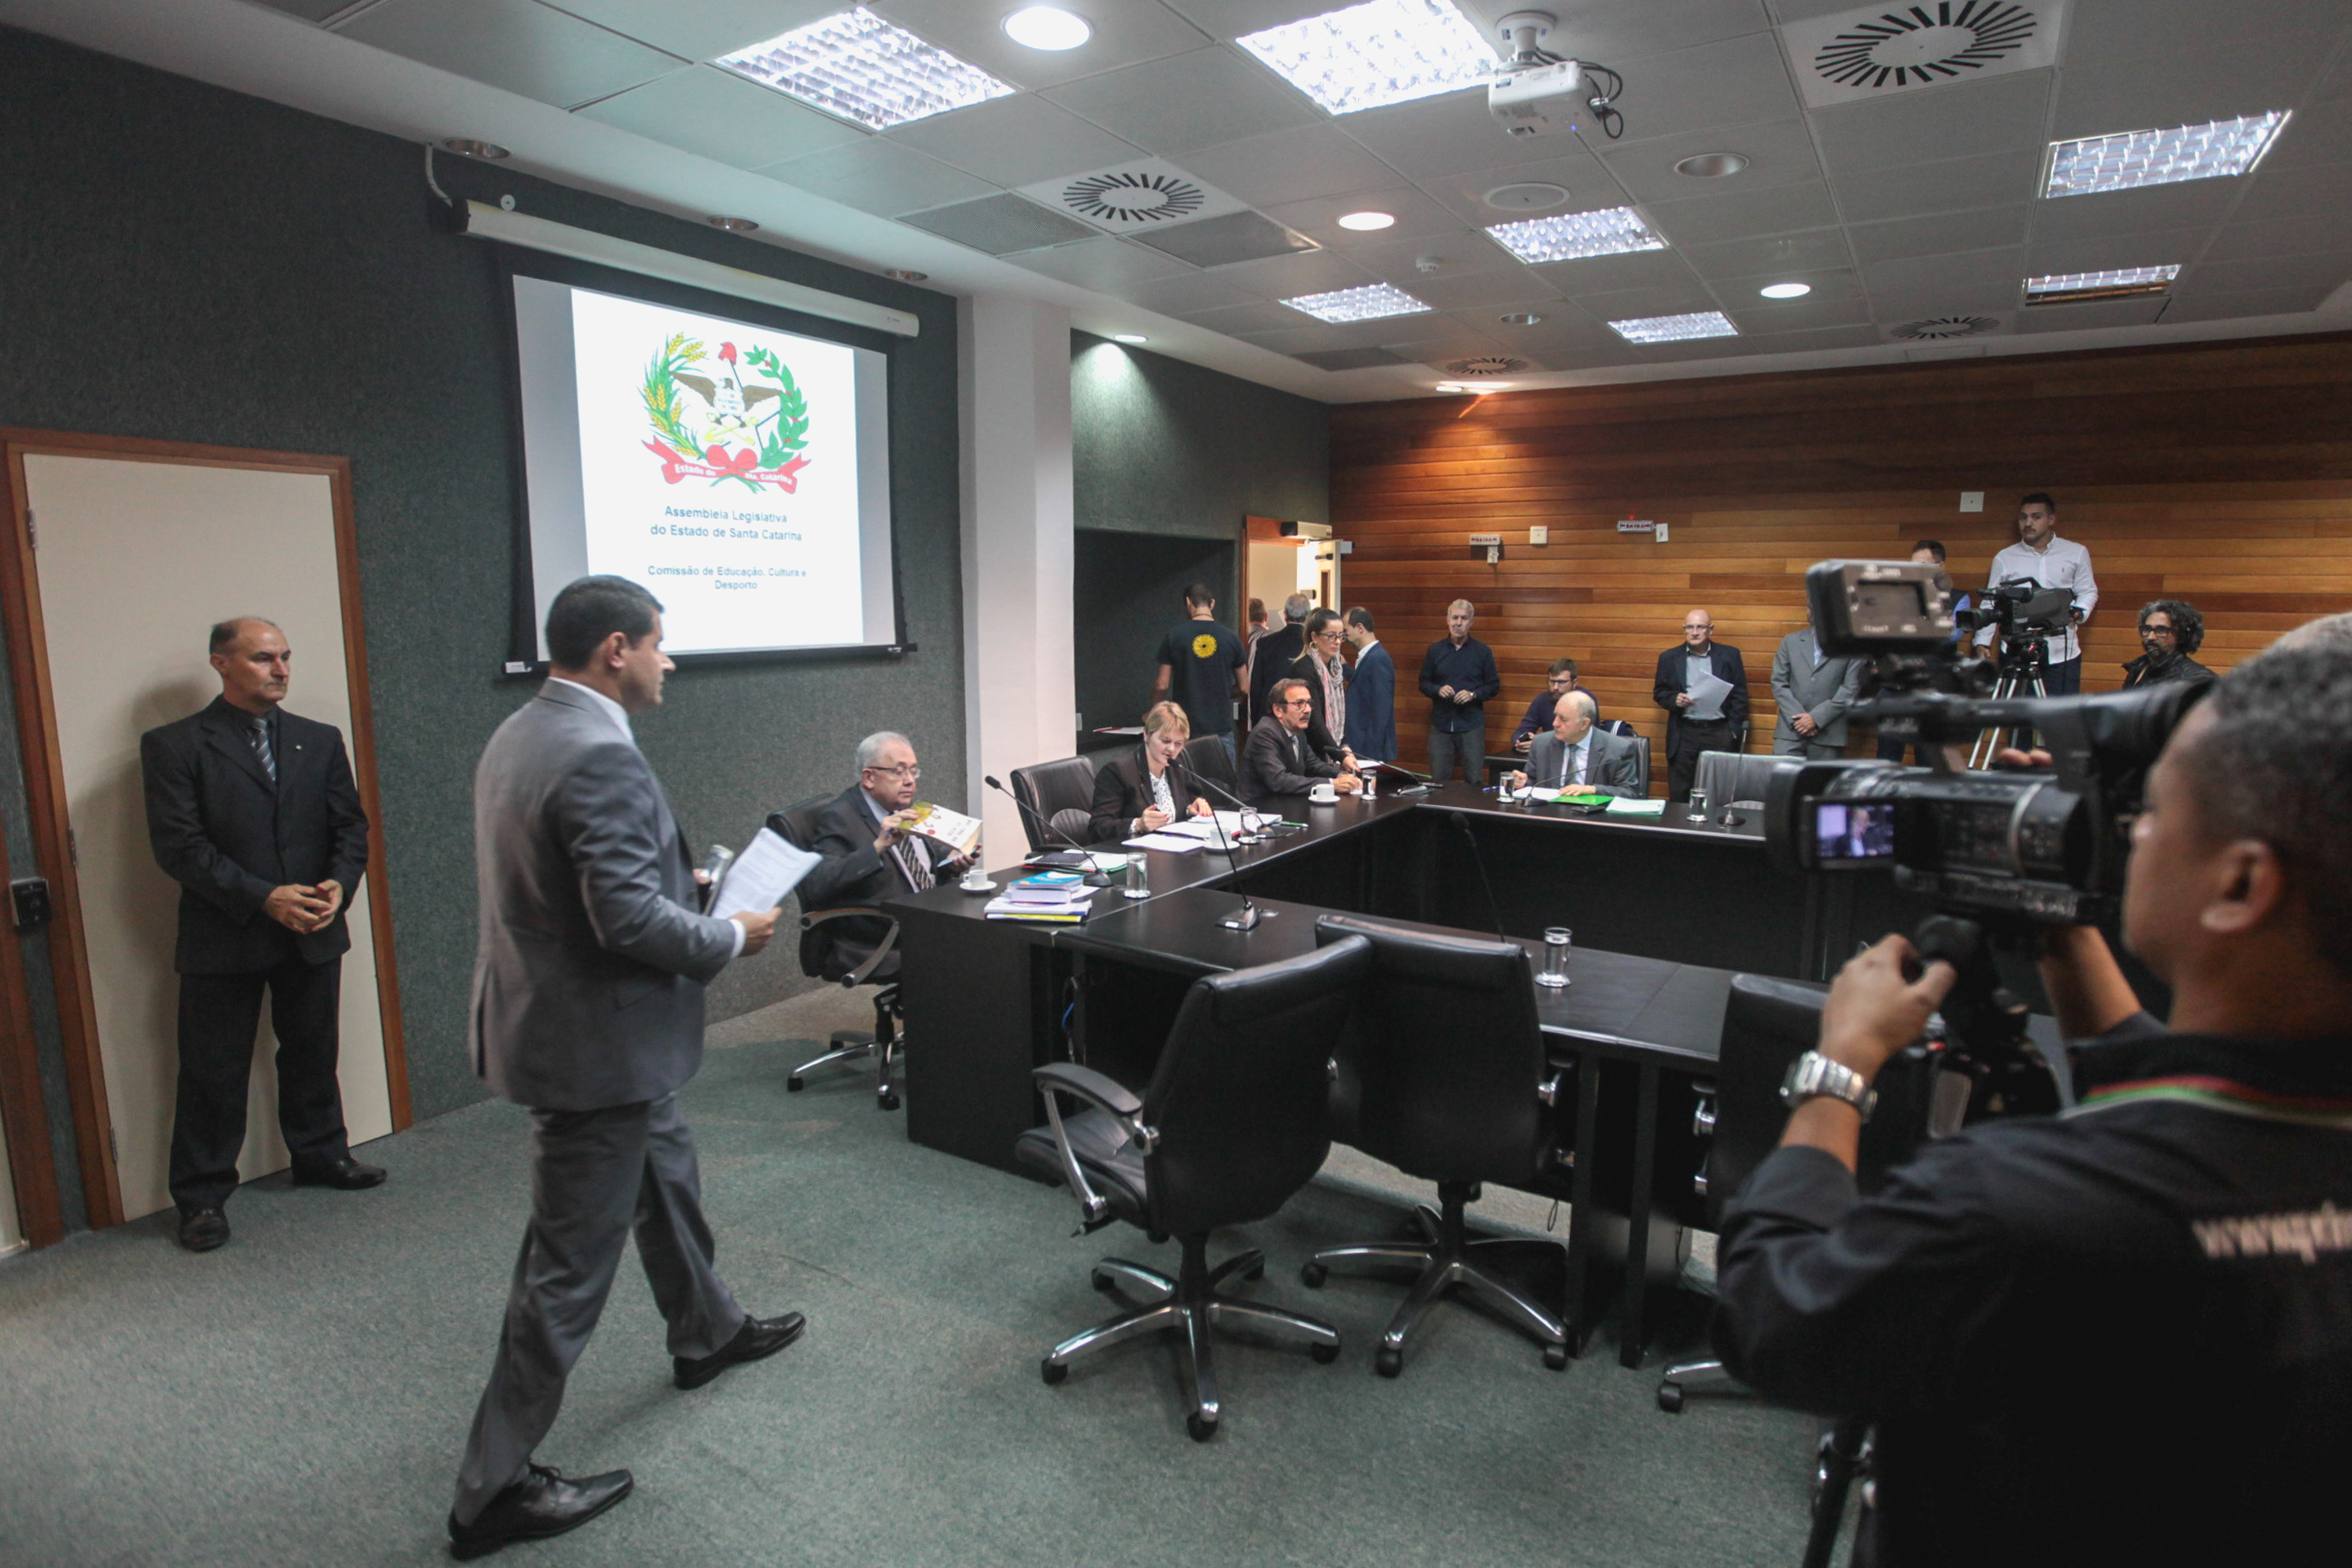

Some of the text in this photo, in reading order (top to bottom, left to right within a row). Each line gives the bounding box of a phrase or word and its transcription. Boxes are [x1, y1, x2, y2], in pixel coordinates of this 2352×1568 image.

[665, 506, 787, 523] Assembleia Legislativa
[650, 524, 802, 542] do Estado de Santa Catarina
[648, 565, 700, 576] Comissão
[703, 566, 714, 576] de
[768, 567, 799, 577] Cultura
[715, 579, 757, 590] Desporto
